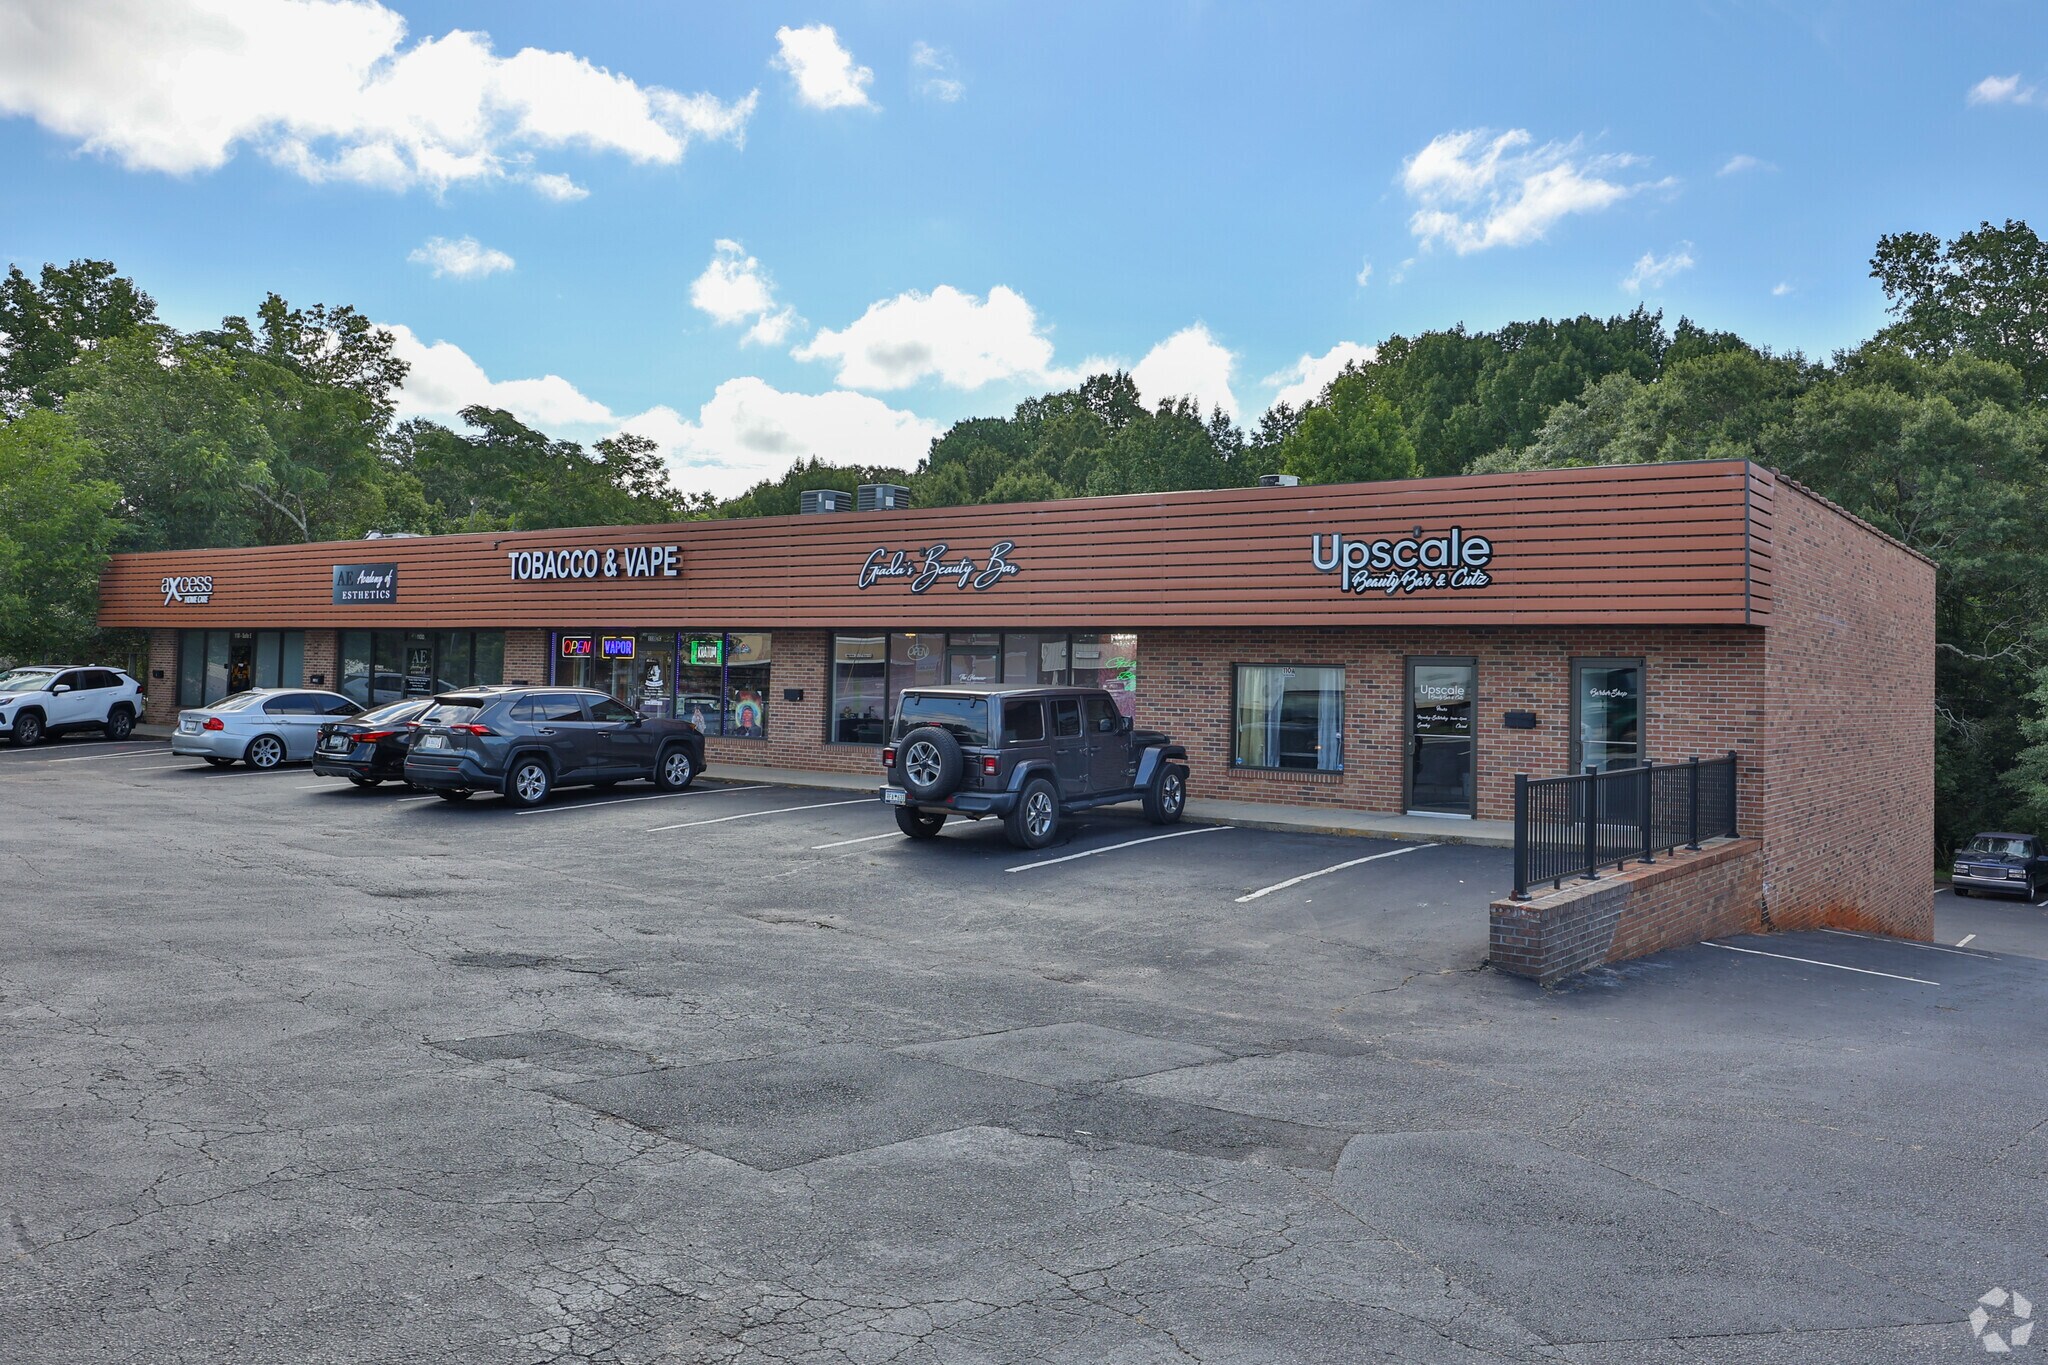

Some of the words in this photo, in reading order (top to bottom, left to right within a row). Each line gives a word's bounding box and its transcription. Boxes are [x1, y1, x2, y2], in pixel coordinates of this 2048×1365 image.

[508, 549, 599, 580] TOBACCO
[603, 548, 618, 577] &
[624, 545, 679, 577] VAPE
[1313, 528, 1491, 590] Upscale
[858, 548, 914, 589] Giada's
[911, 544, 975, 592] Beauty
[973, 542, 1018, 589] Bar
[337, 570, 354, 586] AE
[356, 569, 383, 589] Academy
[384, 568, 394, 588] of
[1352, 570, 1400, 593] Beauty
[1399, 568, 1434, 591] Bar
[1435, 573, 1446, 586] &
[1450, 566, 1490, 587] Cutz
[342, 590, 391, 600] ESTHETICS
[563, 639, 592, 654] OPEN
[604, 641, 632, 655] VAPOR
[411, 649, 428, 664] AE
[1420, 684, 1465, 699] Upscale
[1589, 687, 1611, 698] Barber
[1610, 687, 1628, 698] Shop
